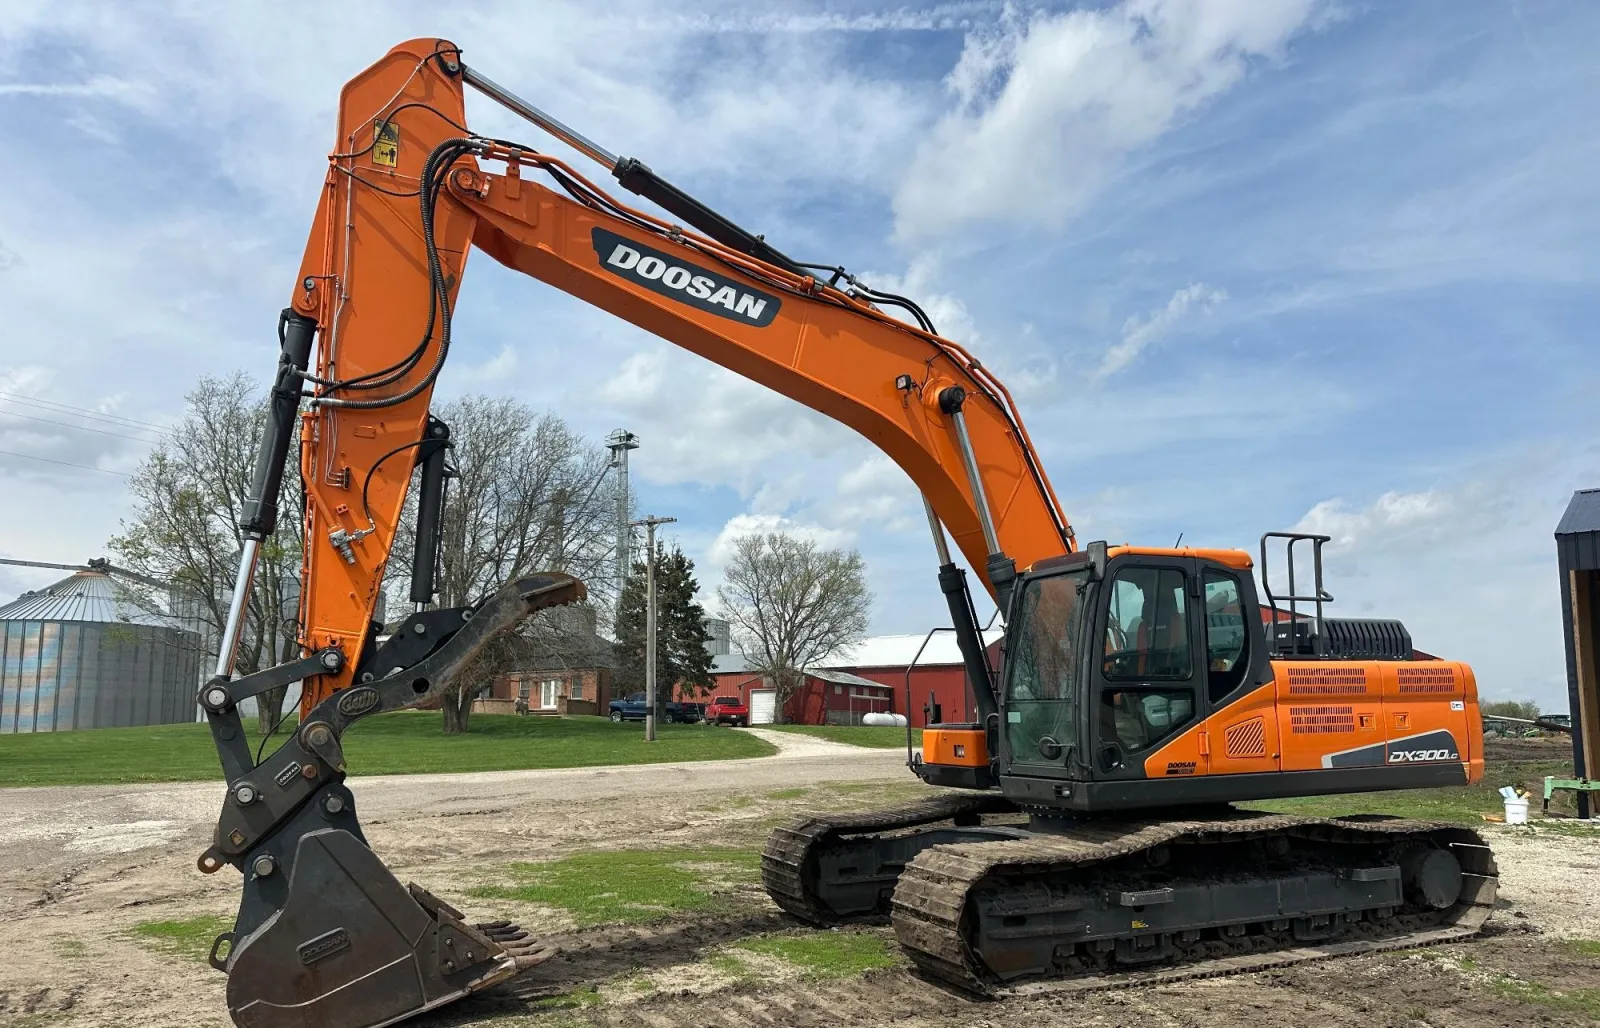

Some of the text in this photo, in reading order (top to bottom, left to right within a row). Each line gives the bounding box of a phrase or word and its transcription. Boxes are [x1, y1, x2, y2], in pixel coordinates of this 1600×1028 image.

[606, 243, 768, 320] DOOSAN
[1167, 761, 1197, 769] DOOSAN
[279, 766, 299, 783] DOOSAN
